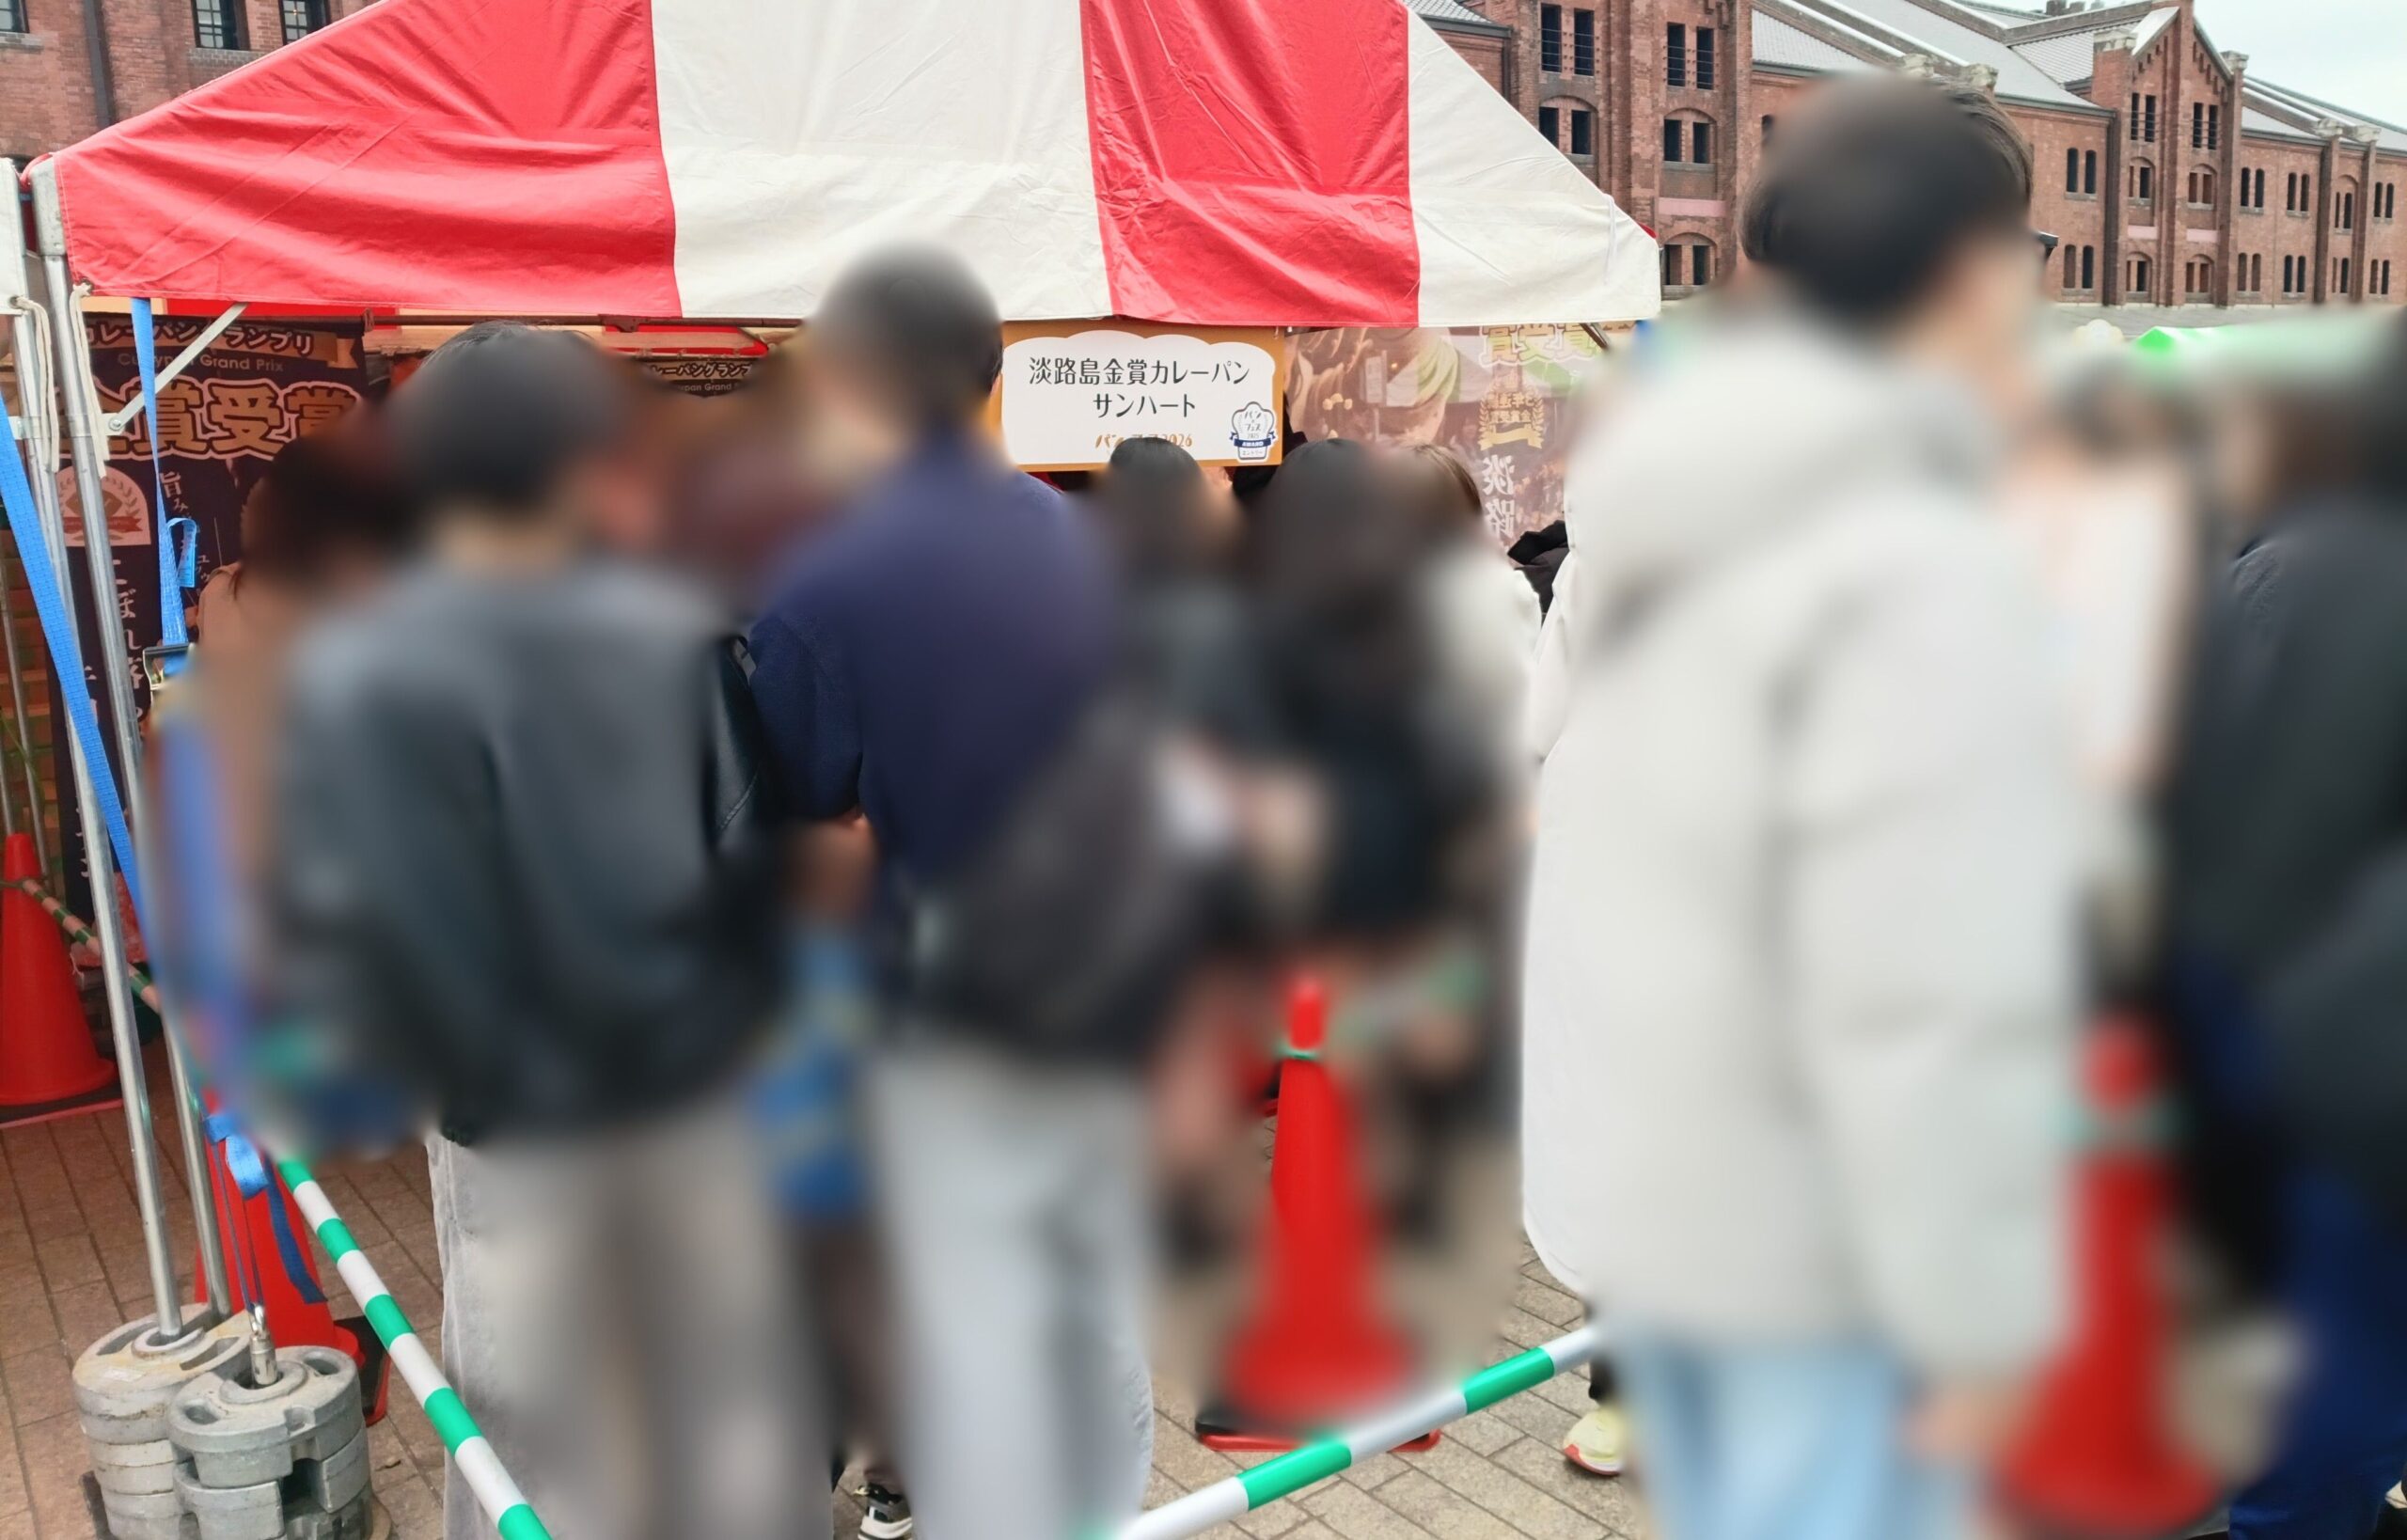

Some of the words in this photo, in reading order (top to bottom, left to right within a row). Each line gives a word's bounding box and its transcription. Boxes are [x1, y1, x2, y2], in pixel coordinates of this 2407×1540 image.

[200, 354, 250, 369] Grand
[257, 358, 284, 371] Prix
[1030, 356, 1251, 385] 淡路島金賞カレーパン
[704, 383, 732, 391] Grand
[58, 376, 358, 459] 賞受賞
[1093, 393, 1196, 418] サンハート
